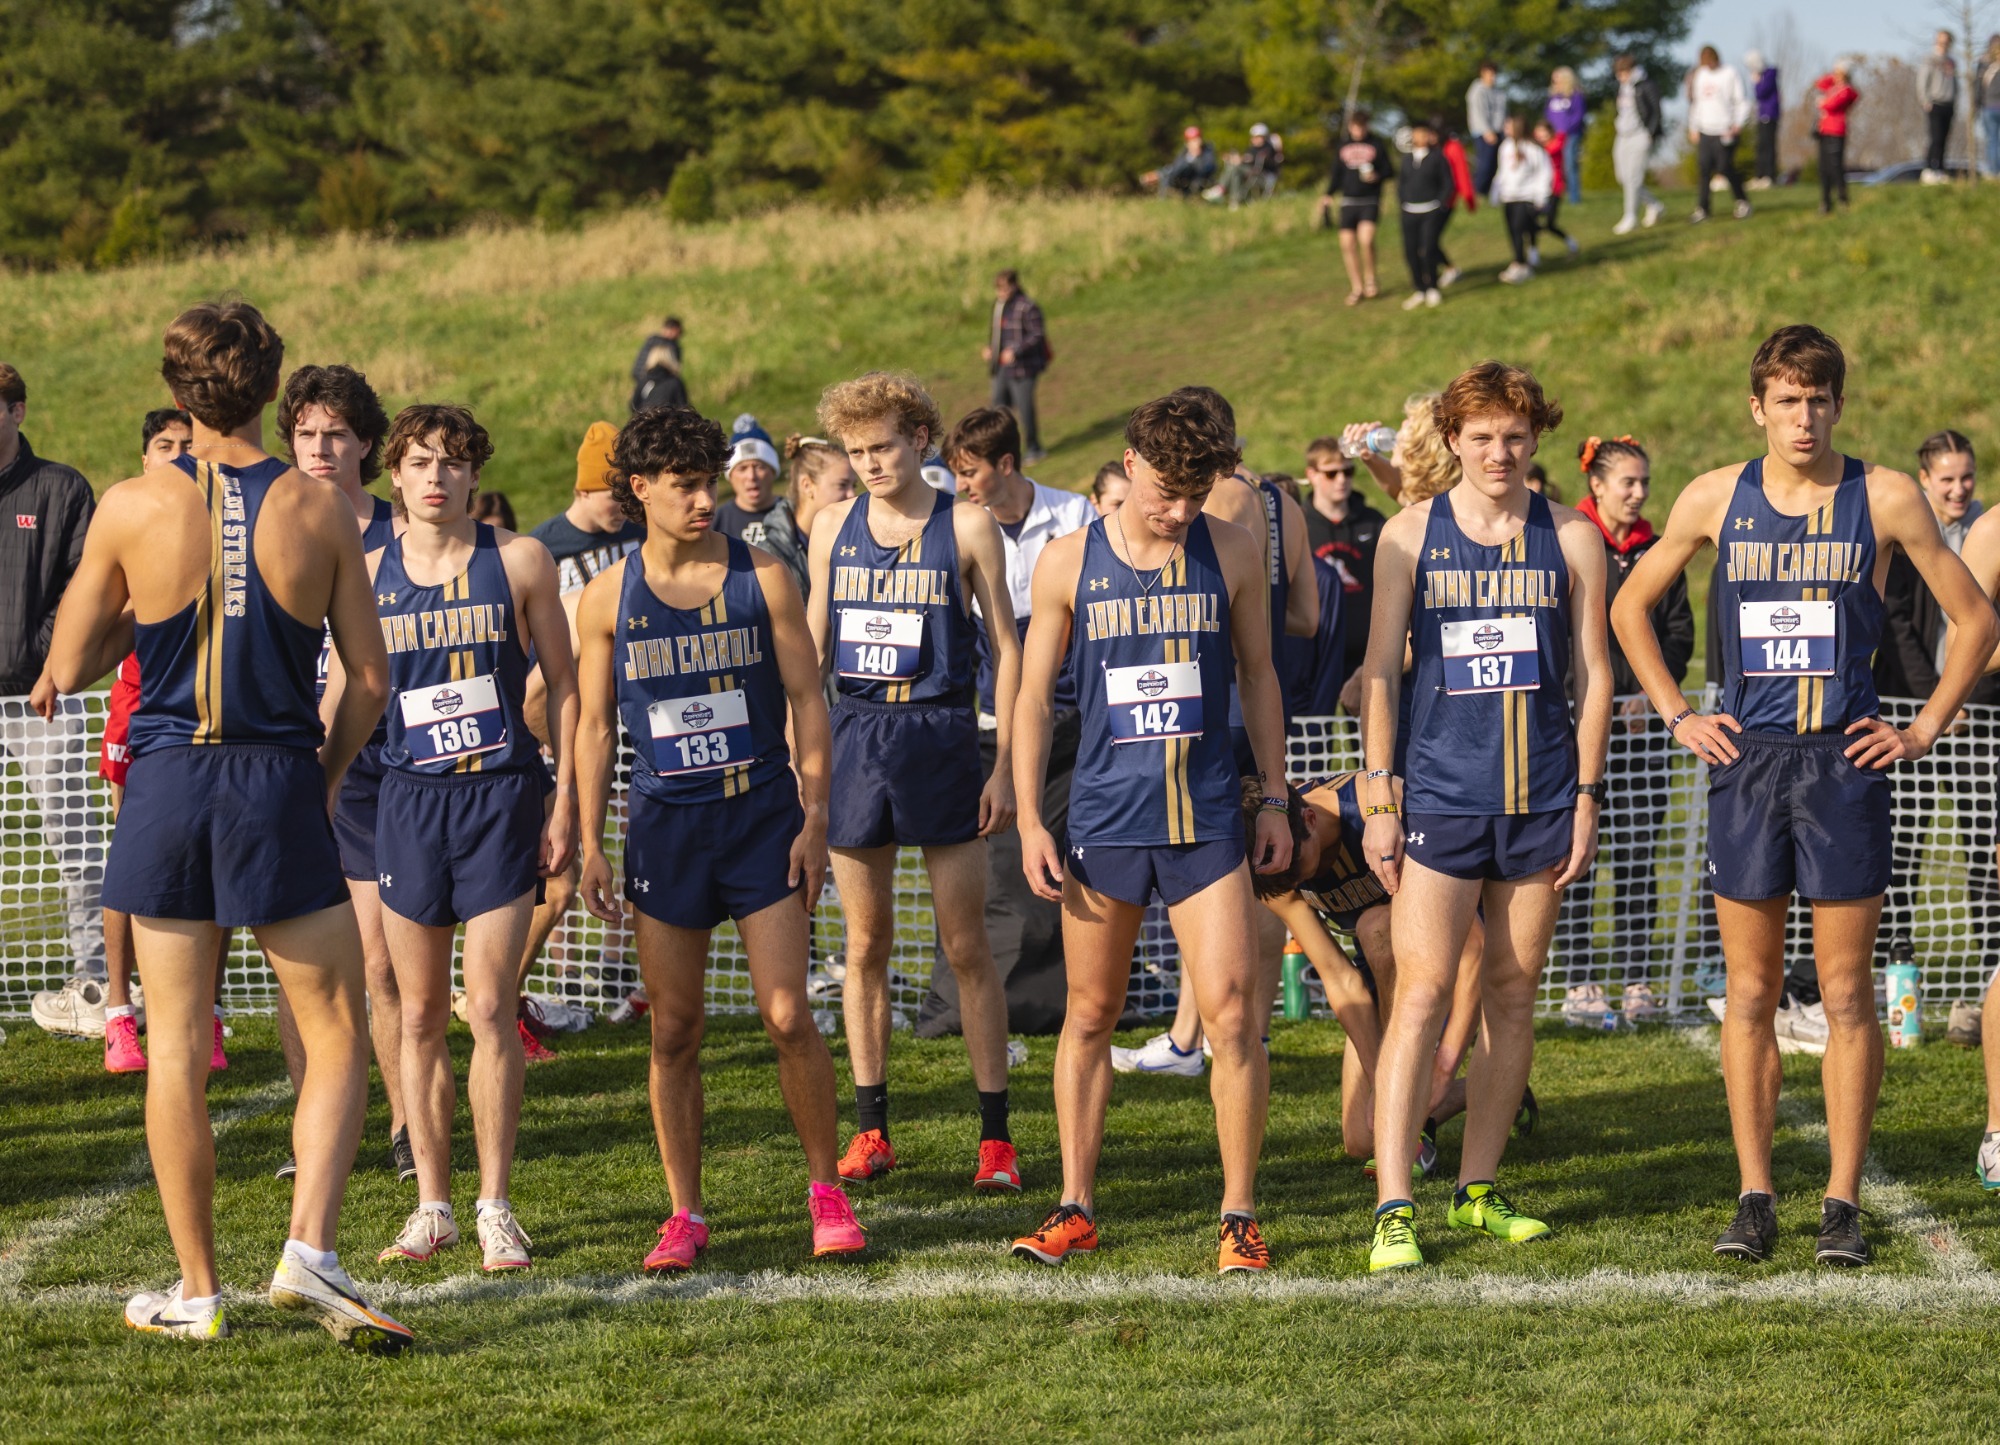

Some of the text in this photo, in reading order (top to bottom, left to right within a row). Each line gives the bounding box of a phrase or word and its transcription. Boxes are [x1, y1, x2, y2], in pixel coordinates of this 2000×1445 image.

[223, 525, 247, 617] STREAKS
[1727, 542, 1863, 583] JOHN CARROLL
[834, 566, 950, 605] JOHN CARROLL
[1423, 570, 1559, 609] JOHN CARROLL
[380, 603, 508, 654] OHN CARROLL
[1086, 593, 1221, 641] JOHN CARROLL
[624, 626, 763, 681] JOHN CARROLL
[855, 645, 898, 675] 140
[1467, 655, 1513, 687] 137
[1762, 639, 1810, 670] 144
[427, 717, 481, 755] 136
[1130, 702, 1181, 735] 142
[106, 742, 129, 763] W.
[675, 732, 730, 767] 133
